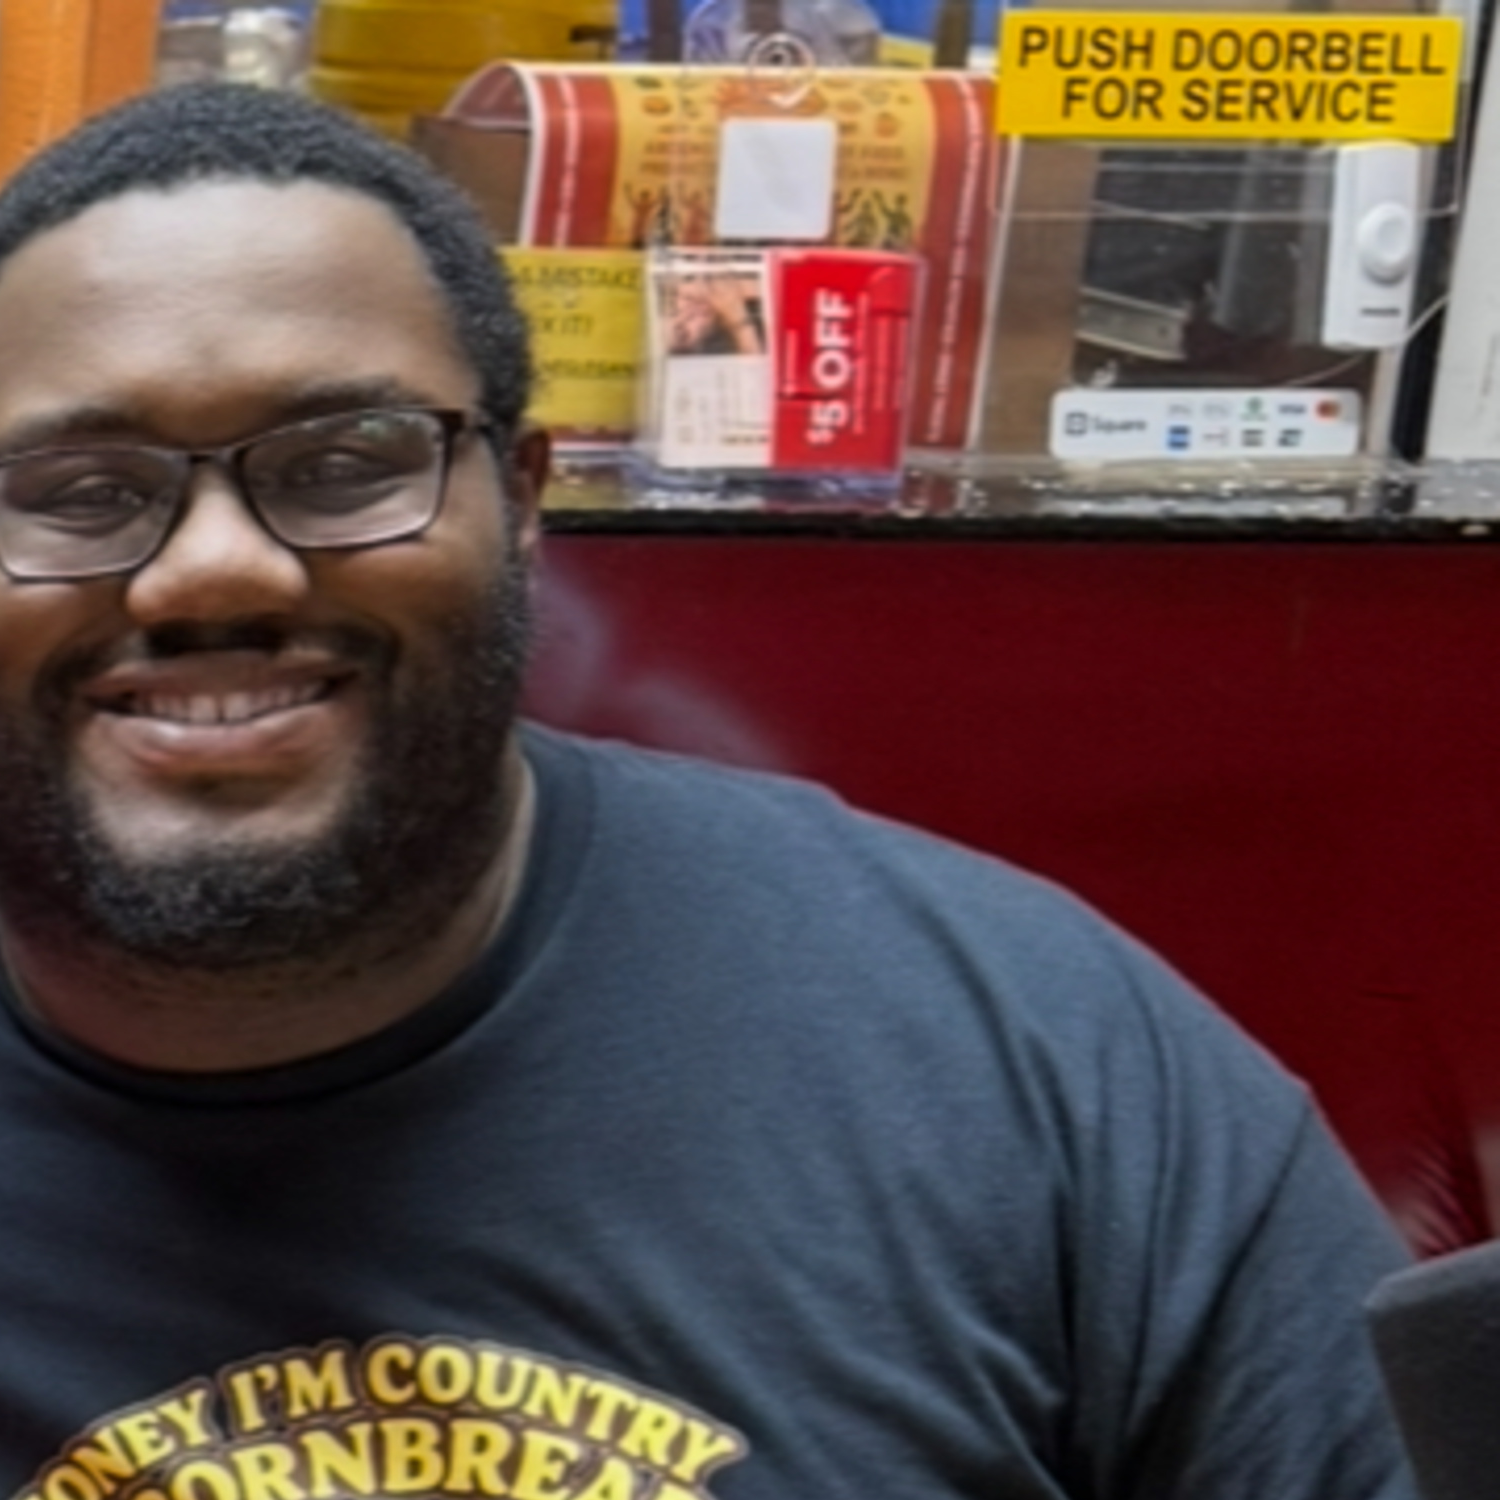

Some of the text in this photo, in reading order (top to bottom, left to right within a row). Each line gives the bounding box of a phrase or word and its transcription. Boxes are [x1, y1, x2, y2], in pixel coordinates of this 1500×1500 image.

[1018, 25, 1448, 77] PUSH DOORBELL
[1060, 76, 1398, 124] FOR SERVICE
[805, 287, 854, 447] $5 OFF
[227, 1349, 356, 1435] I'M
[365, 1342, 738, 1484] COUNTRY
